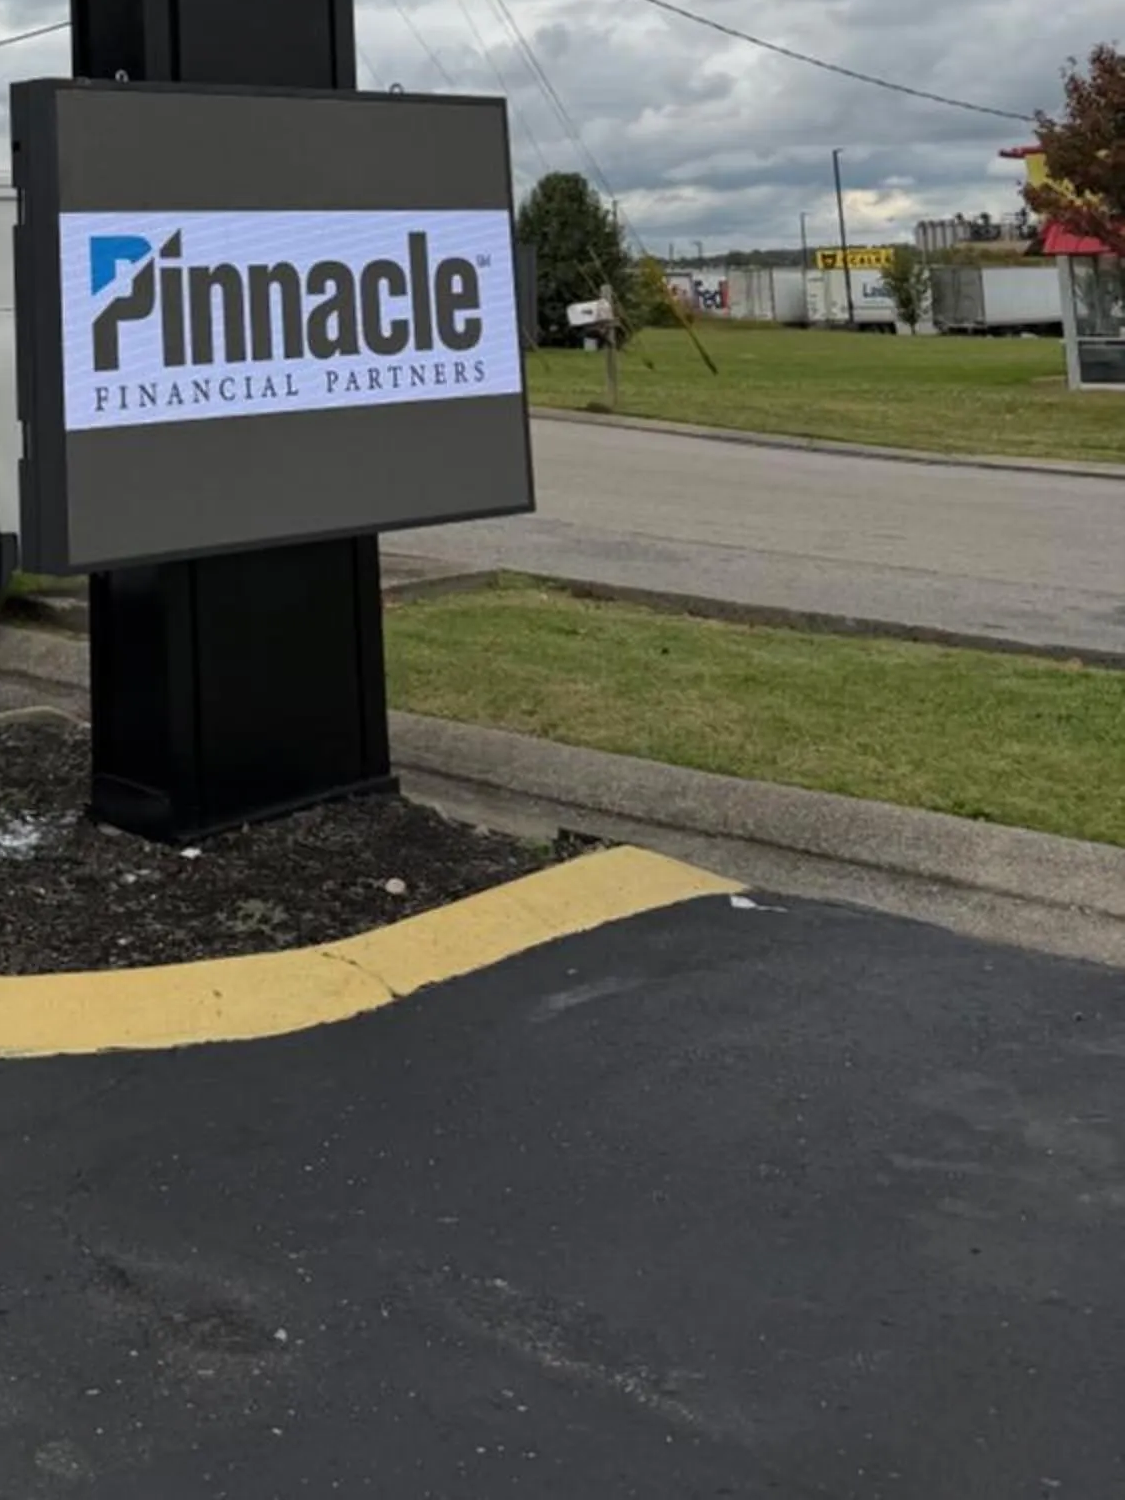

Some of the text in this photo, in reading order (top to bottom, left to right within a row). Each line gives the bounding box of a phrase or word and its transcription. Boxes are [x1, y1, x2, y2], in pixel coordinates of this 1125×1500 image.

[89, 229, 483, 372] Pinnacle
[94, 361, 487, 412] FINANCIAL PARTNERS
